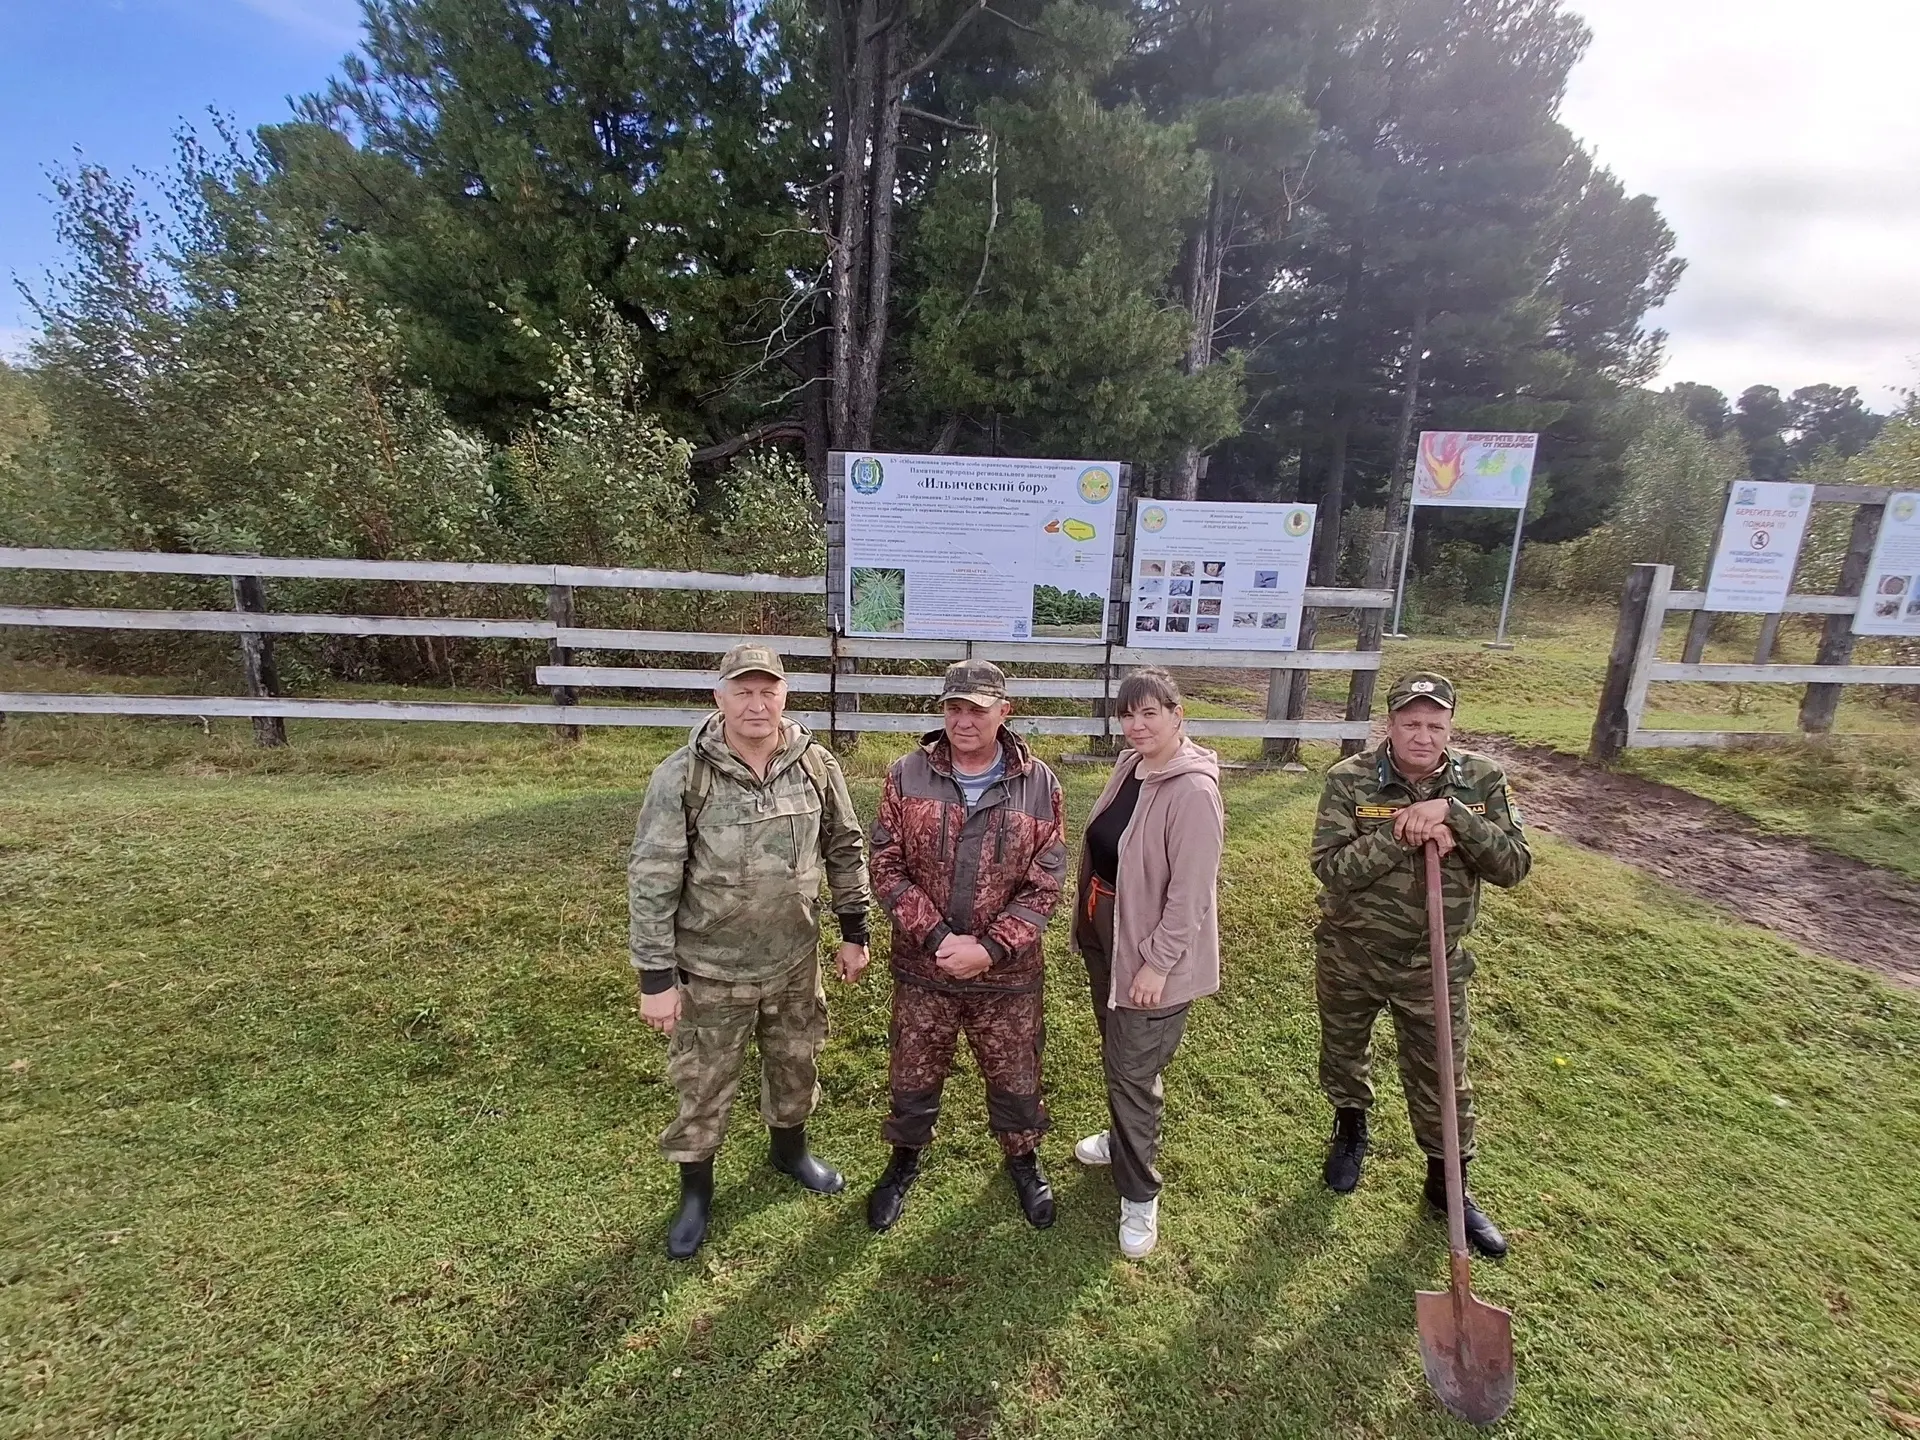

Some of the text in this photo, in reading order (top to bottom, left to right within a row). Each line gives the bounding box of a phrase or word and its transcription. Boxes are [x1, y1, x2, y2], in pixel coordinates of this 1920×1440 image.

[1467, 434, 1514, 442] БЕРЕГИТЕ
[946, 469, 975, 477] природы
[917, 477, 1048, 496] «Ильичевский бор»
[1736, 508, 1770, 517] БЕРЕГИТЕ
[1788, 510, 1799, 518] ОТ
[1743, 520, 1775, 528] ПОЖАРА
